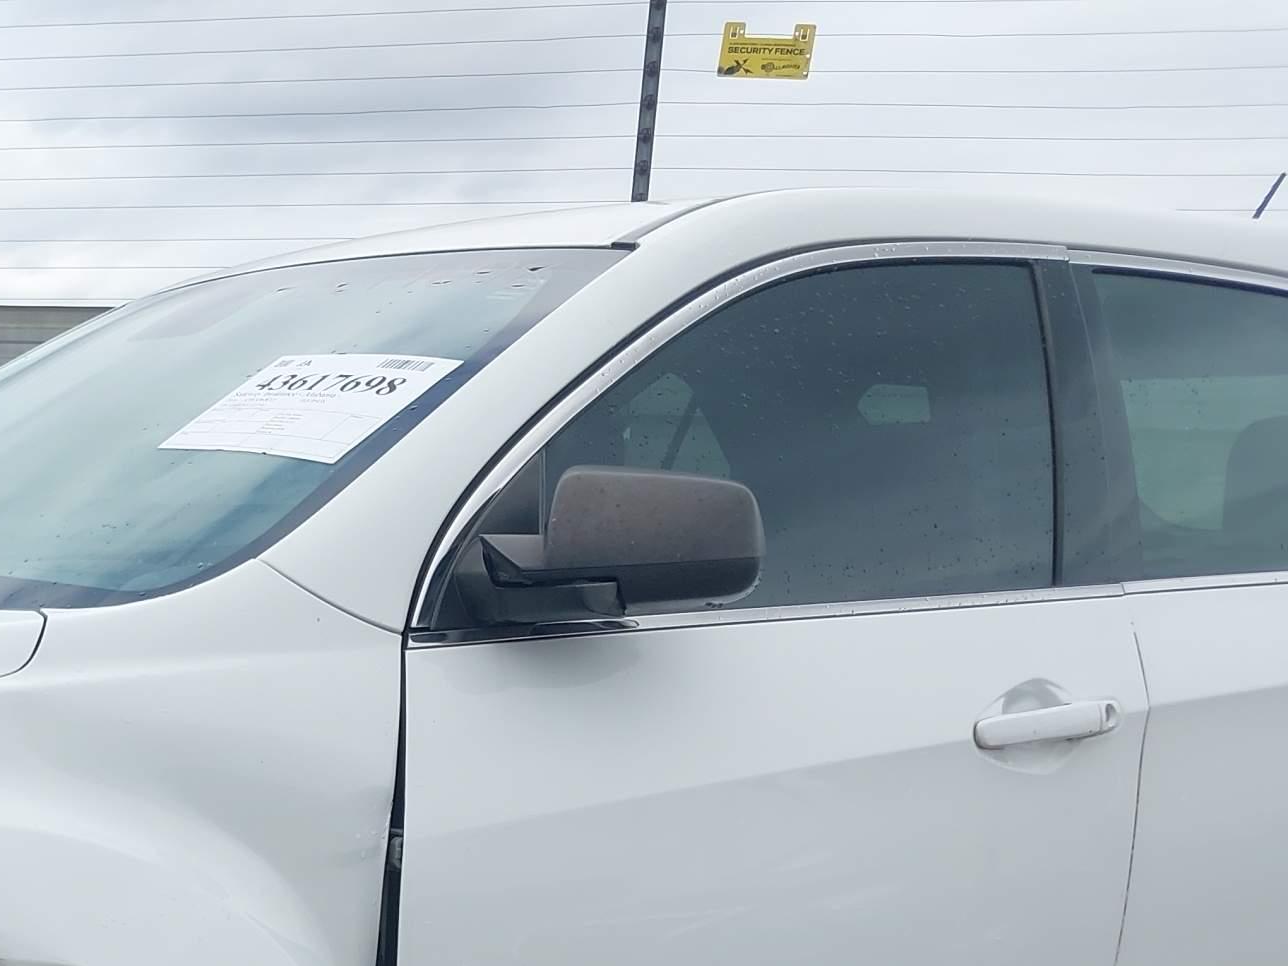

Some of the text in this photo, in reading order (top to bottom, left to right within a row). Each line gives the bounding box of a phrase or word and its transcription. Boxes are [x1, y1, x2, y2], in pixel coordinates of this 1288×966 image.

[727, 46, 807, 56] SECURITY FENCE
[255, 373, 408, 396] 43617698
